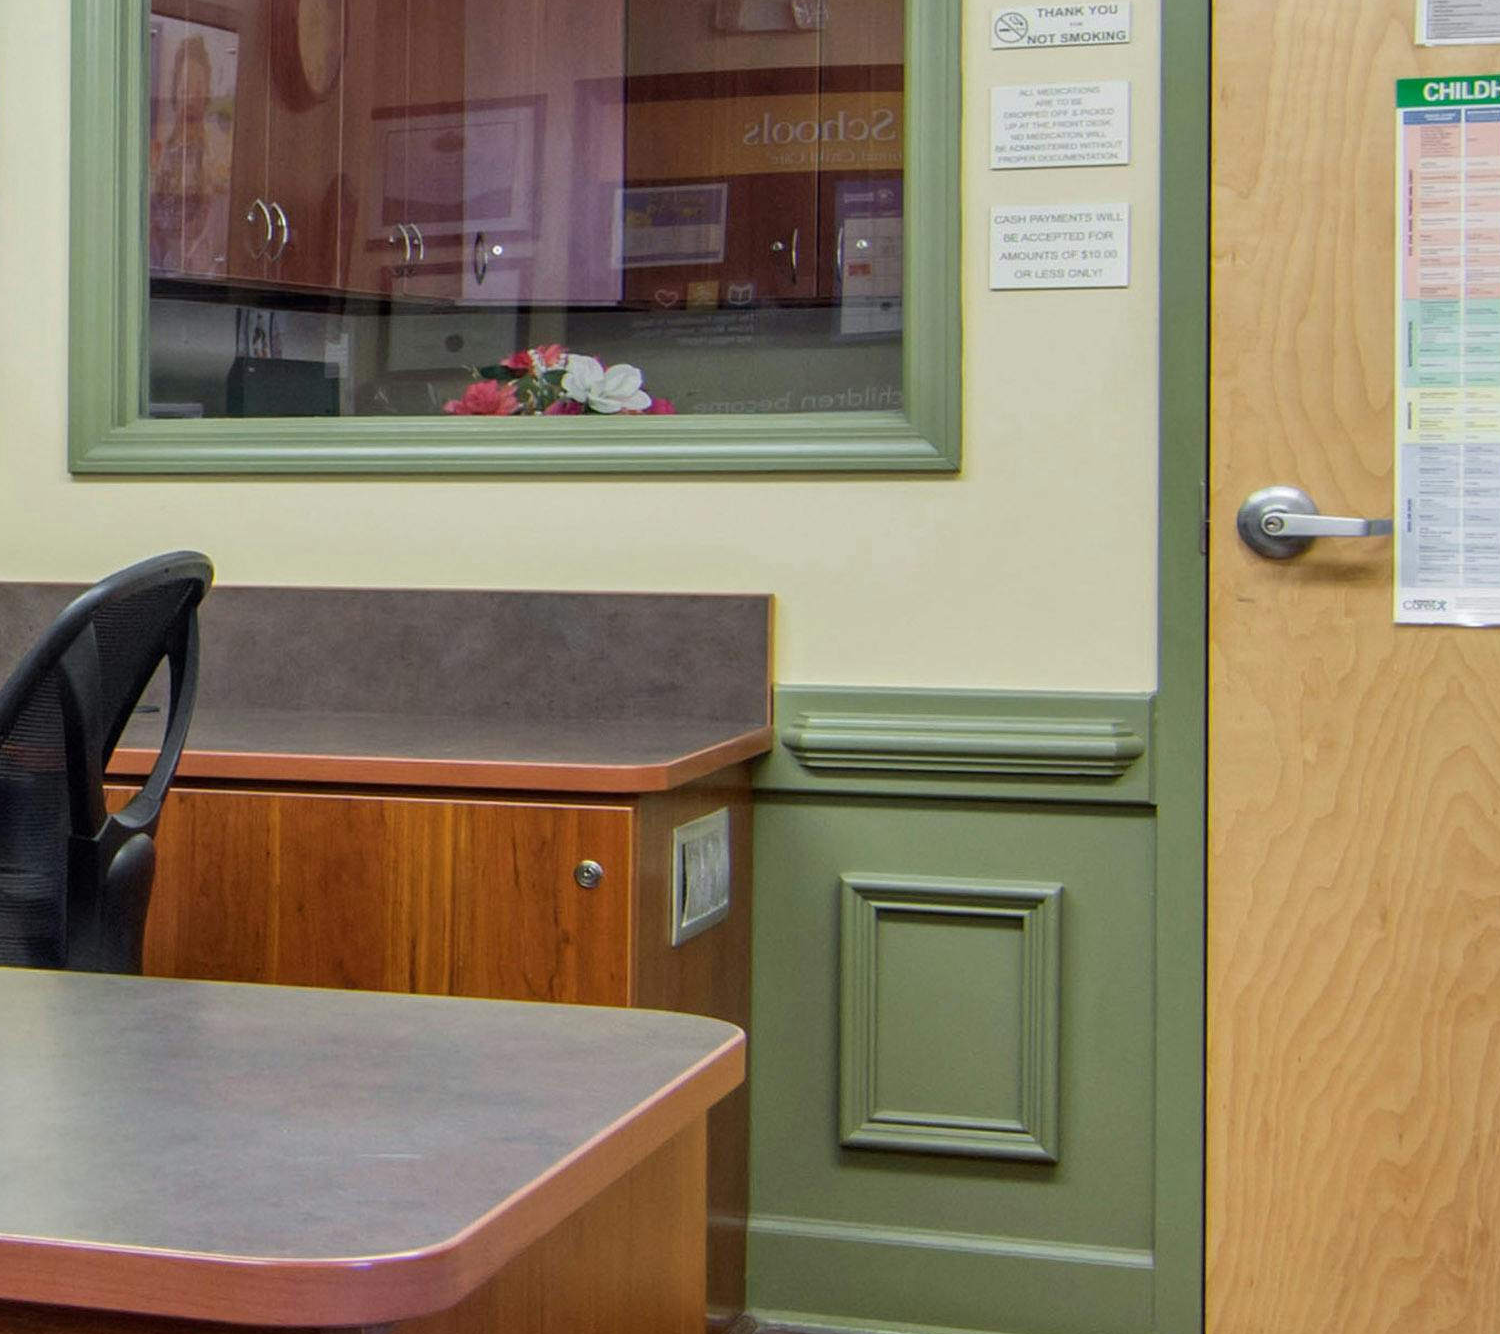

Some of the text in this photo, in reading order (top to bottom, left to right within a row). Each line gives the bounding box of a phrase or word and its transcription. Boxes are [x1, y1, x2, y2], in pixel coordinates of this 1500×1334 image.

[1037, 5, 1118, 18] THANK YOU
[1027, 30, 1126, 44] NOT SMOKING
[994, 213, 1123, 225] CASH PAYMENTS WILL
[1003, 231, 1113, 243] BE ACCEPTED FOR
[999, 251, 1059, 261] AMOUNTS
[1061, 250, 1078, 259] OF
[1014, 269, 1033, 279] OR
[1035, 269, 1064, 279] LESS
